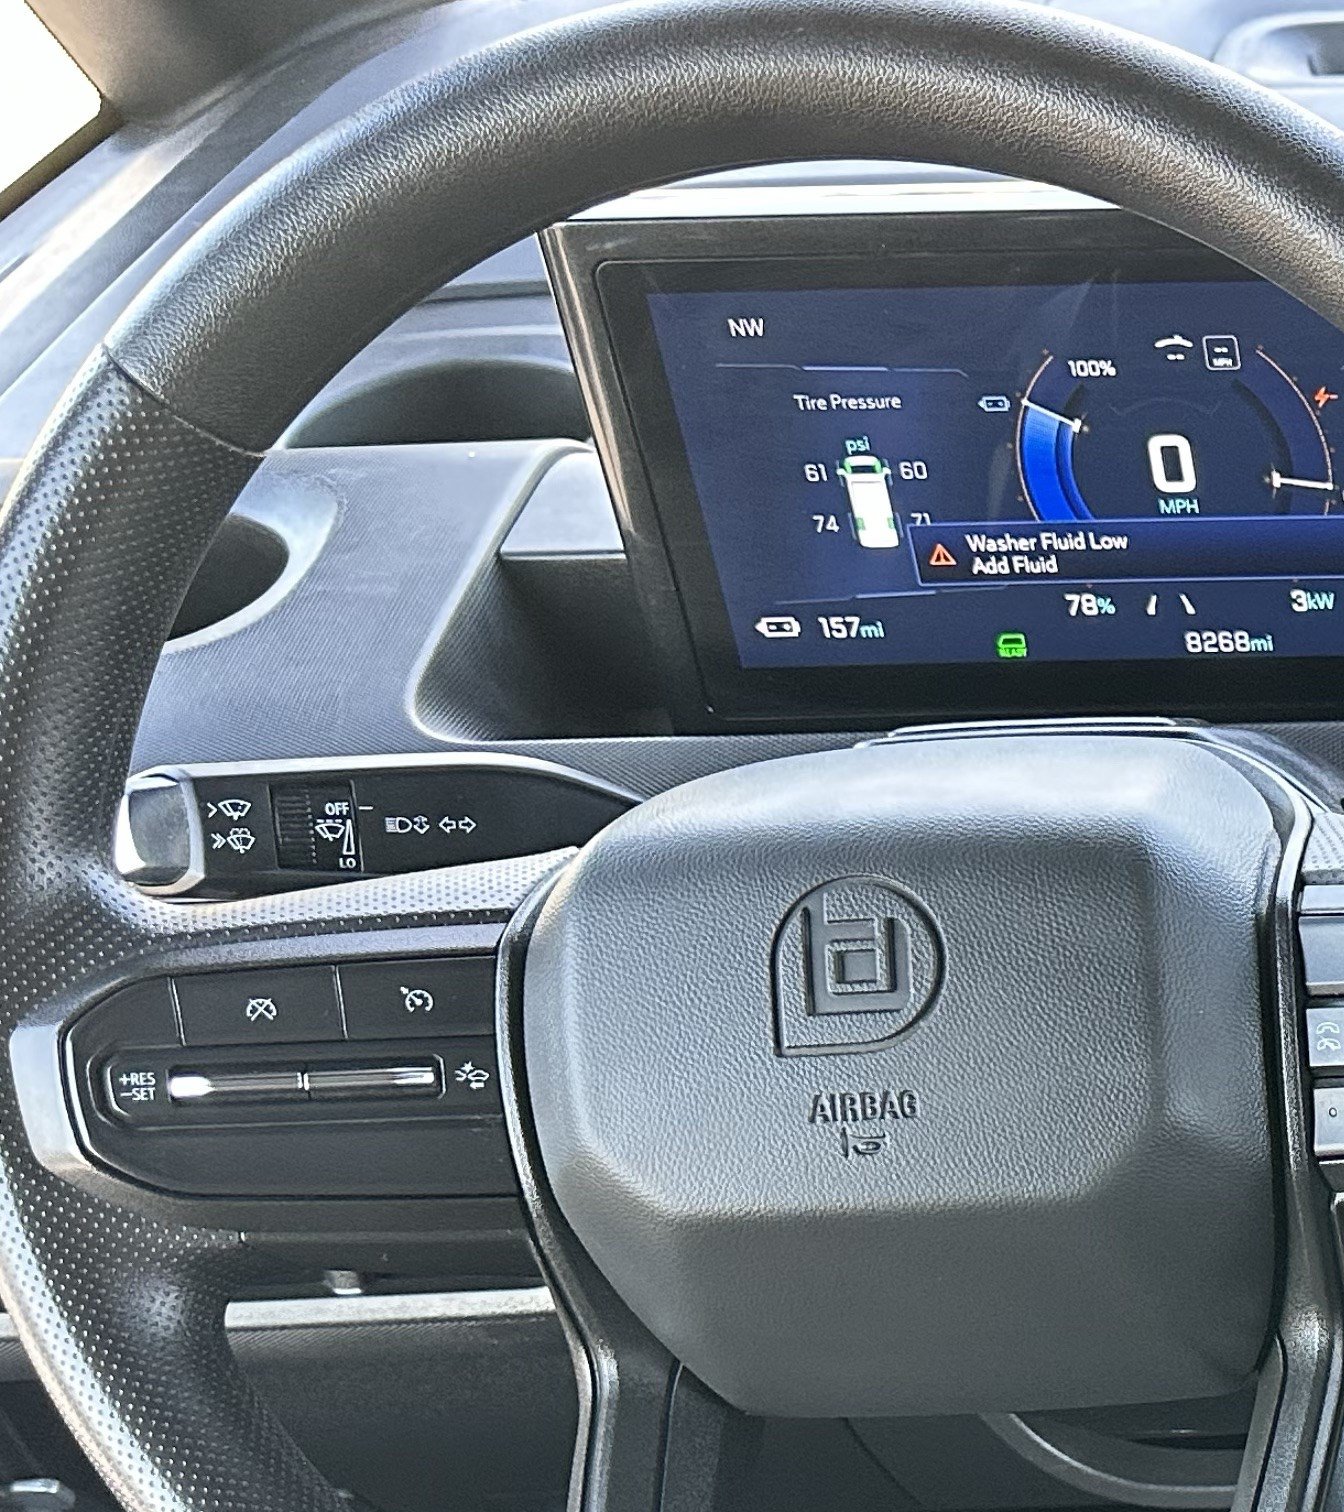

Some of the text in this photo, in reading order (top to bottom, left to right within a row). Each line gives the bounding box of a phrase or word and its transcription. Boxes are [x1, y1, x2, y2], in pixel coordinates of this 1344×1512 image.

[727, 317, 764, 337] NW
[1067, 359, 1116, 377] 100%
[793, 393, 902, 411] Tire Pressure
[845, 436, 872, 454] psi
[804, 463, 828, 482] 61
[899, 461, 928, 480] 60
[1147, 434, 1197, 493] 0
[1158, 498, 1200, 514] MPH
[812, 515, 840, 533] 74
[964, 530, 1128, 553] Washer Fluid Low
[972, 554, 1059, 575] Add Fluid
[1064, 593, 1116, 617] 78%
[1290, 589, 1335, 612] 3kW
[817, 616, 885, 639] 157mi
[1184, 630, 1274, 653] 8268mi
[324, 801, 350, 816] OFF
[338, 856, 358, 869] LO
[118, 1072, 156, 1086] +RES
[807, 1089, 920, 1124] AIRBAG
